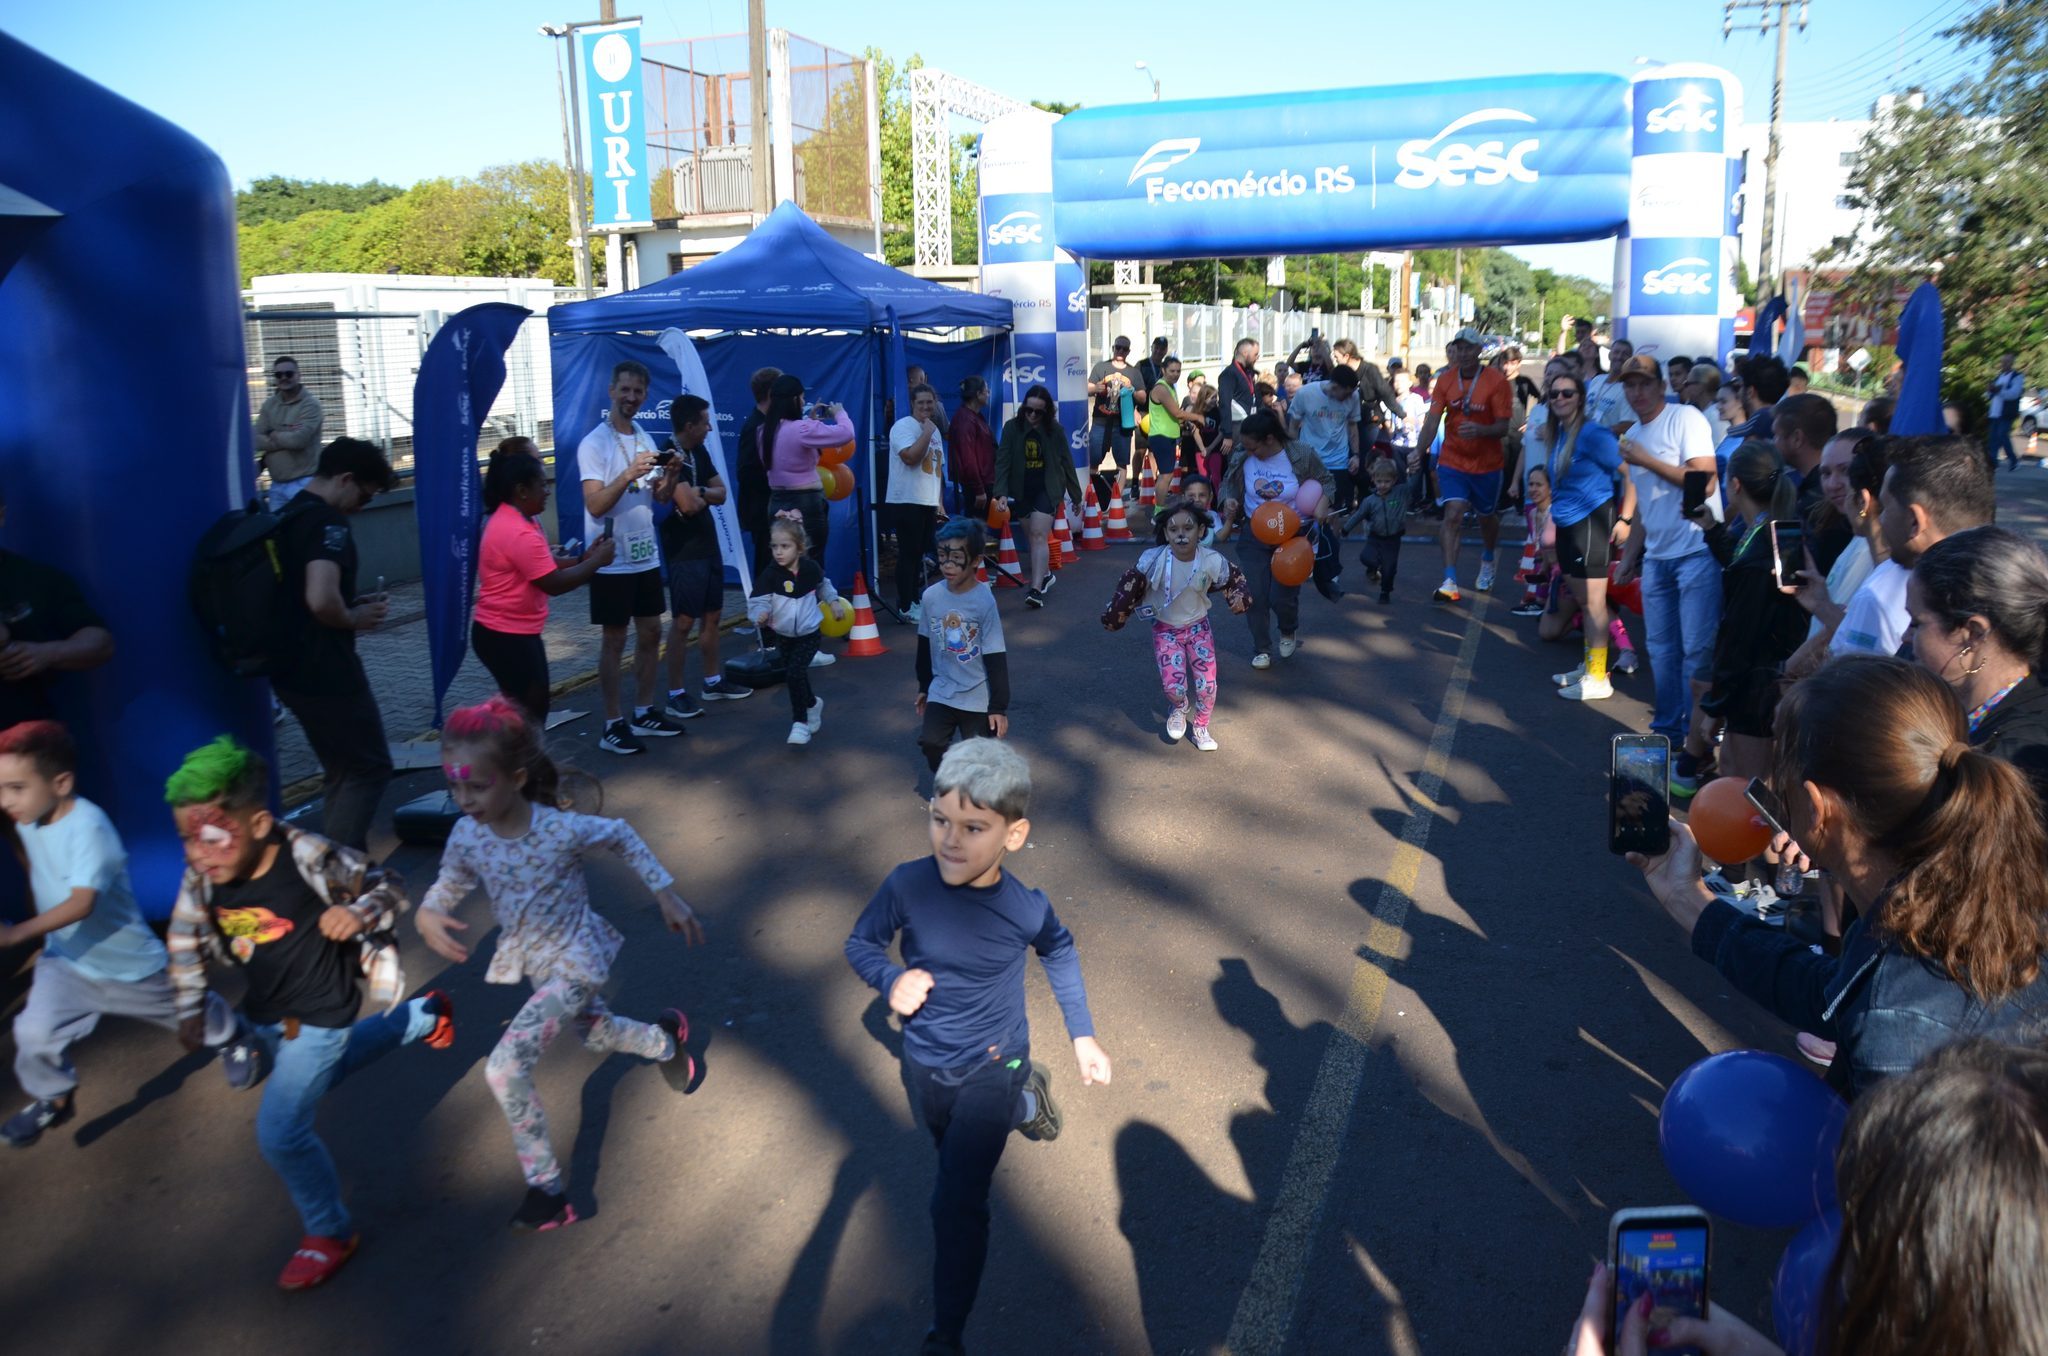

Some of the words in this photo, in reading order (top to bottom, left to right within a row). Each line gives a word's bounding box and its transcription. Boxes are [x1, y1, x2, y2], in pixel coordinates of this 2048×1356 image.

[599, 91, 636, 221] URI
[1146, 169, 1307, 204] Fecomércio
[1315, 165, 1355, 194] RS
[1013, 300, 1036, 309] ércio
[1039, 299, 1052, 308] RS
[1003, 365, 1046, 384] esc
[631, 540, 655, 560] 566
